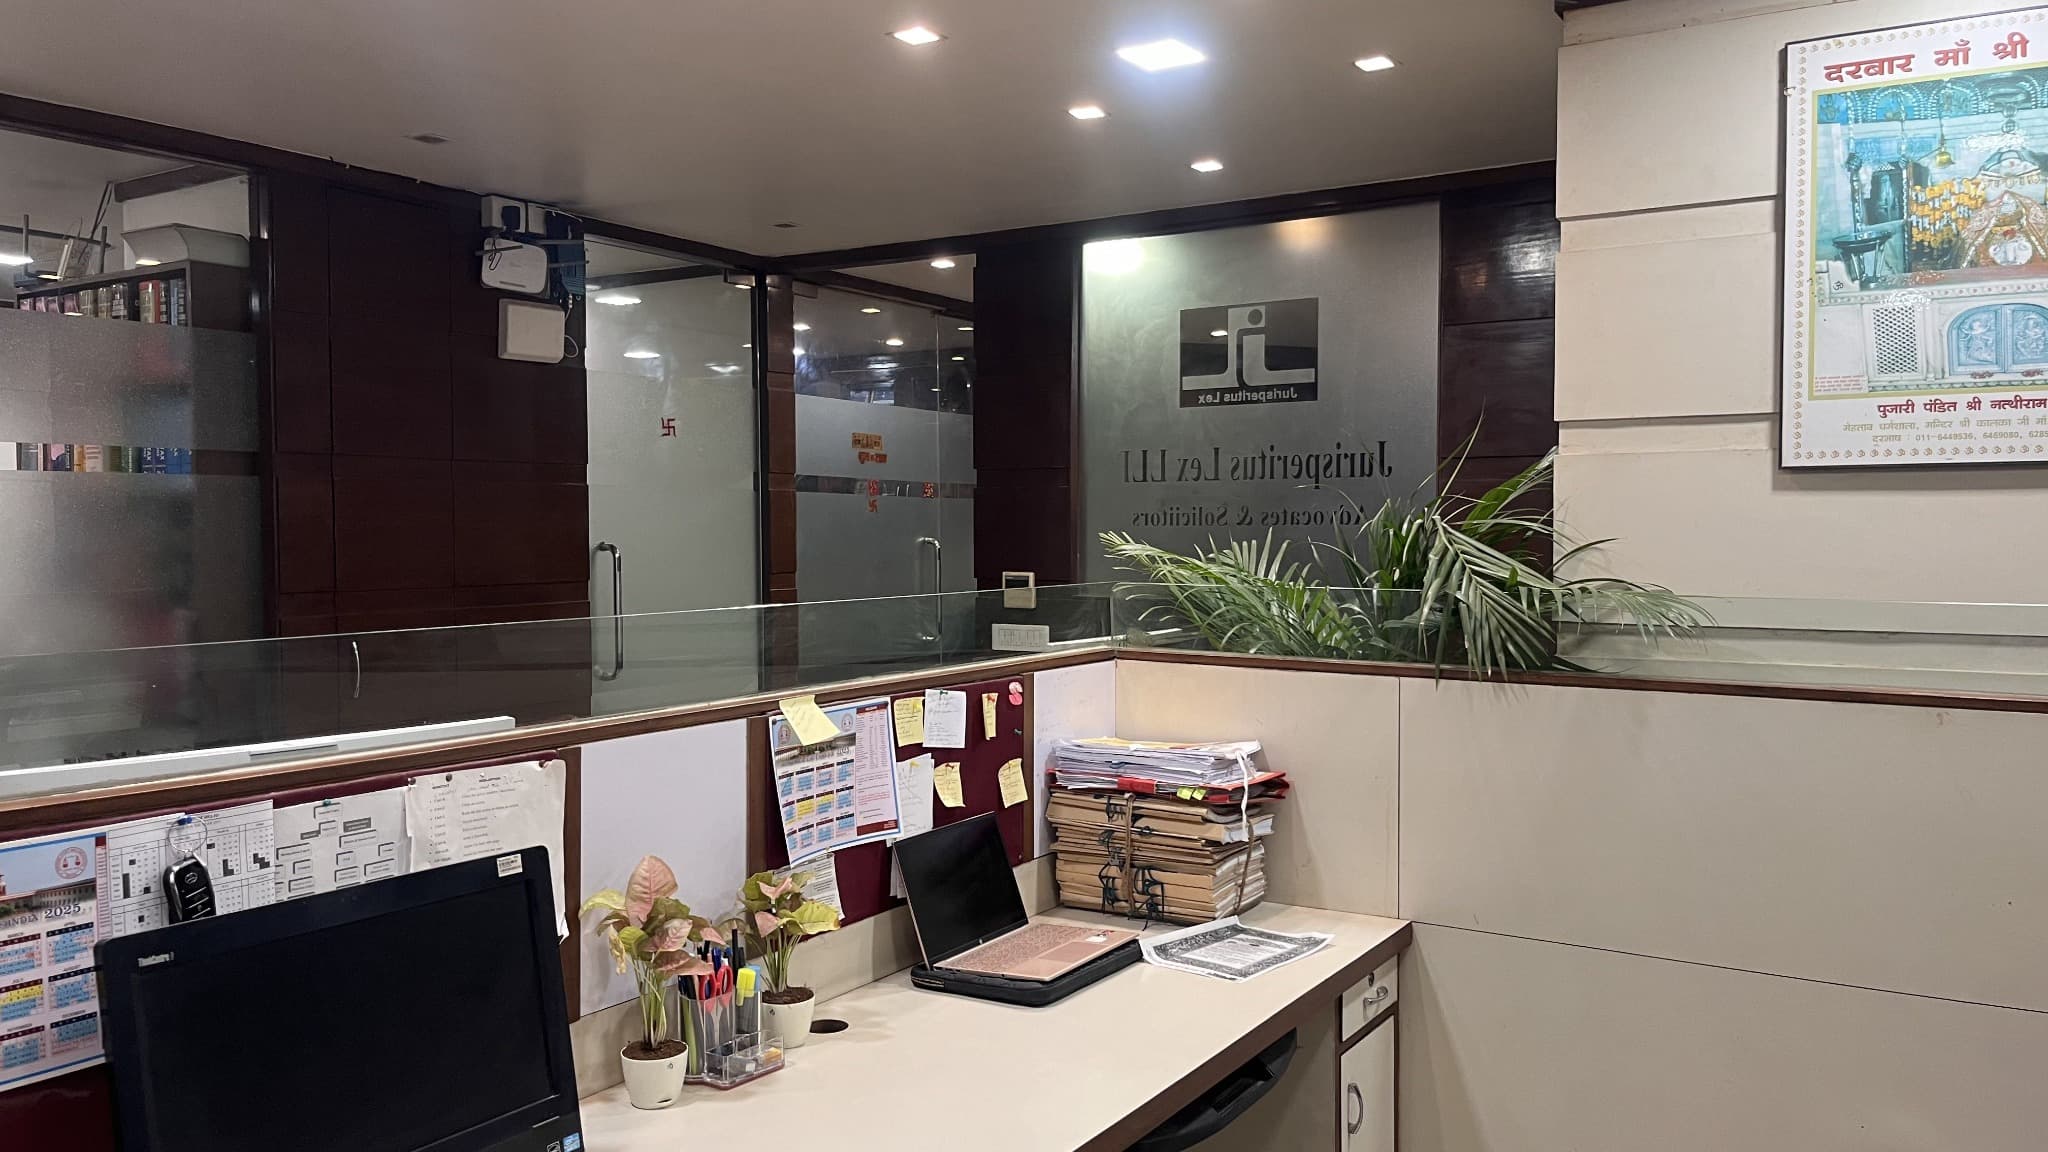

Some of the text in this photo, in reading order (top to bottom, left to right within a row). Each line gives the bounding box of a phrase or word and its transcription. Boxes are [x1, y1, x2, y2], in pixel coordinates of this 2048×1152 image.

[1824, 32, 2030, 82] दरबार माँ श्री
[1877, 400, 1915, 418] पुजारी
[1923, 398, 1957, 413] पंडित
[1966, 396, 1982, 411] श्री
[45, 904, 81, 919] 2025
